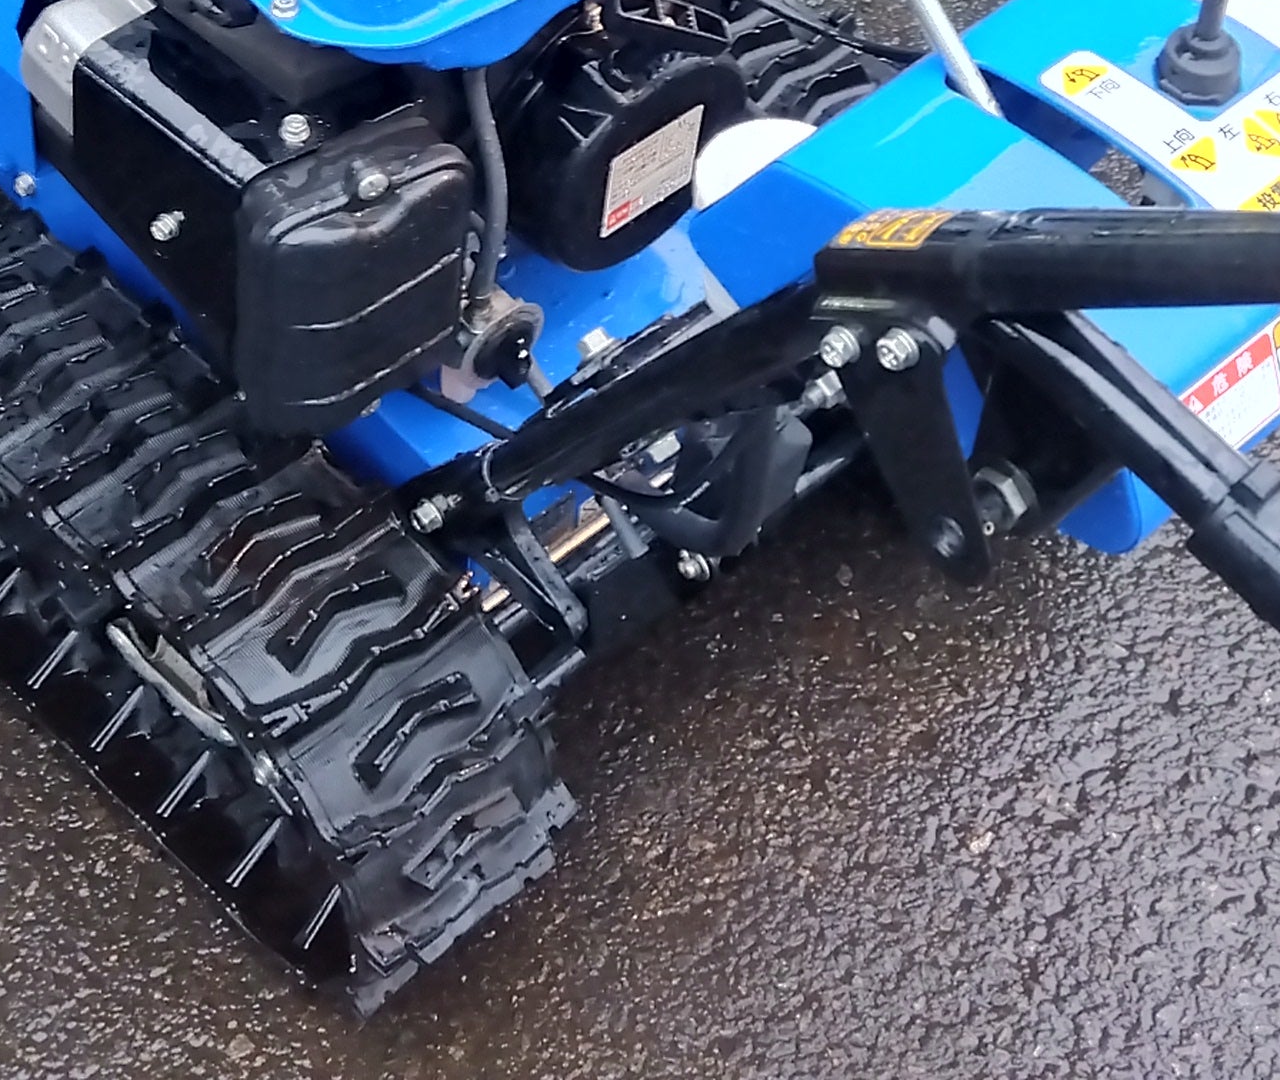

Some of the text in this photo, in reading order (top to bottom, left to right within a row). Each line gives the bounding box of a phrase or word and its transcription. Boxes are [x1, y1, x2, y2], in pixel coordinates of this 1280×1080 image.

[1086, 77, 1121, 100] 下向
[1162, 126, 1196, 155] 上向
[1217, 121, 1241, 141] 左
